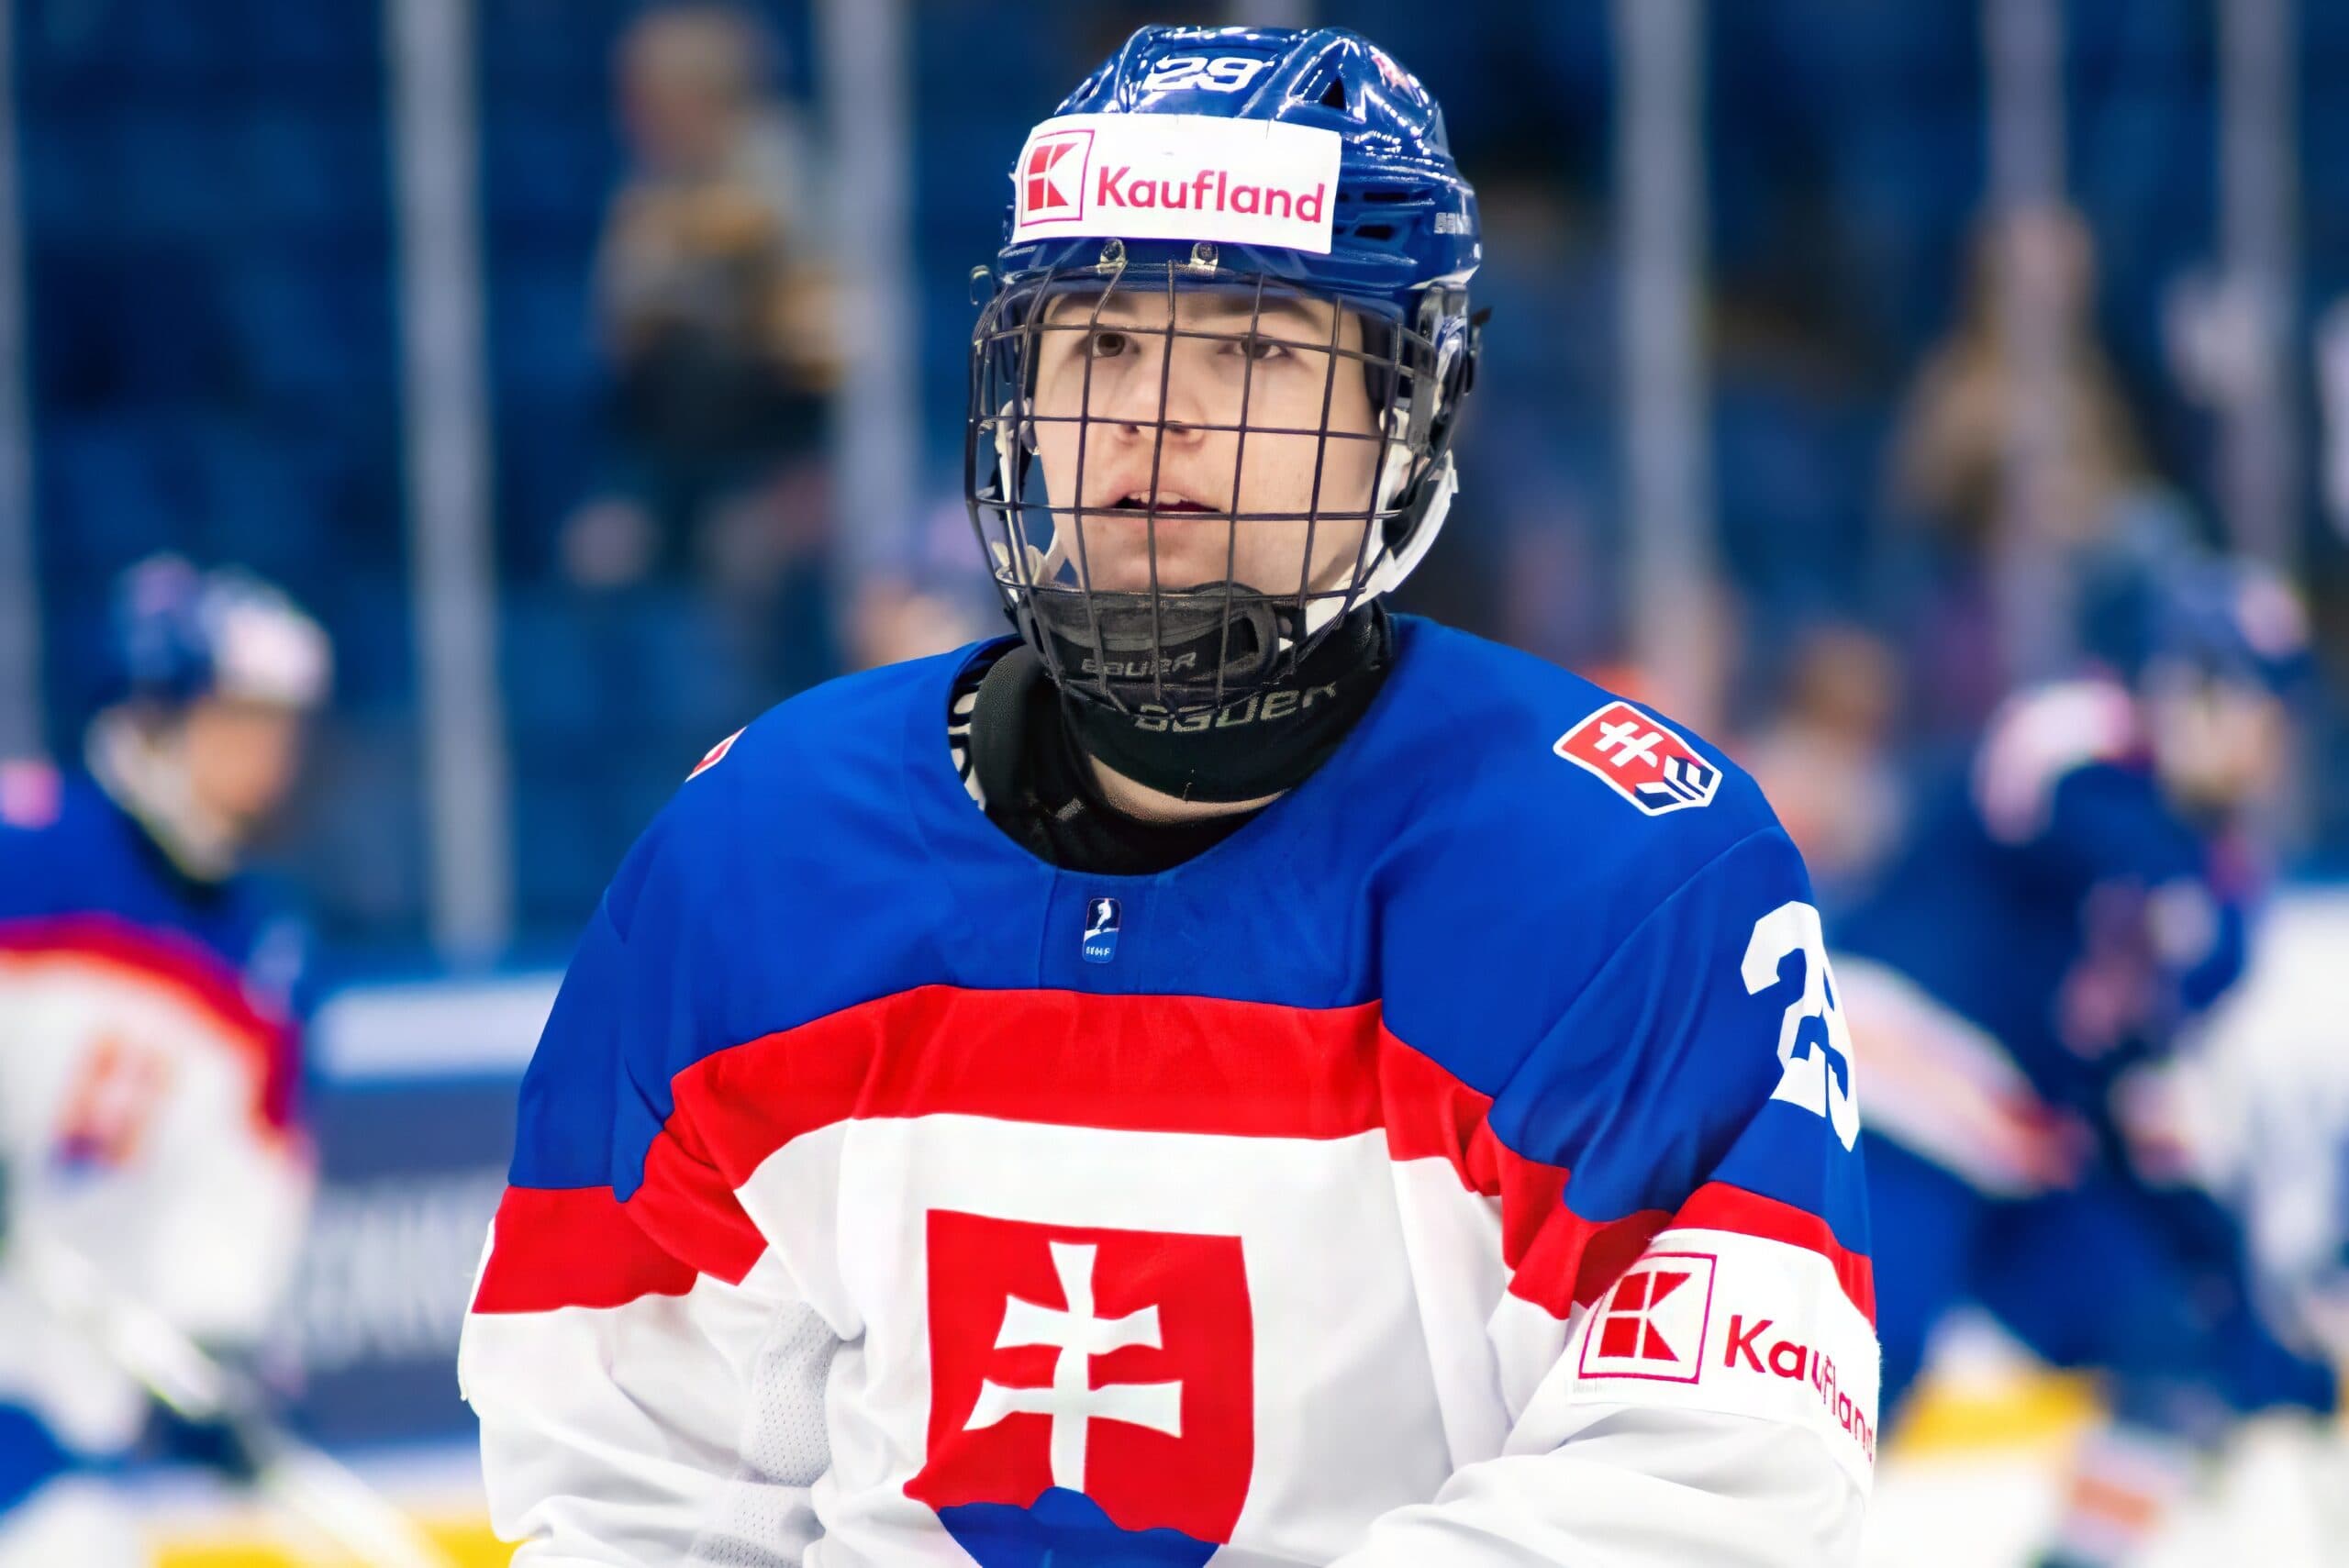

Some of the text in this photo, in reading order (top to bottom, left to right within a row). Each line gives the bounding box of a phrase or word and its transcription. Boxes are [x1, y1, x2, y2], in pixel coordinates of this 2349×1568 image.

[1143, 57, 1264, 93] 29
[1097, 166, 1325, 223] Kaufland
[1741, 900, 1860, 1153] 29
